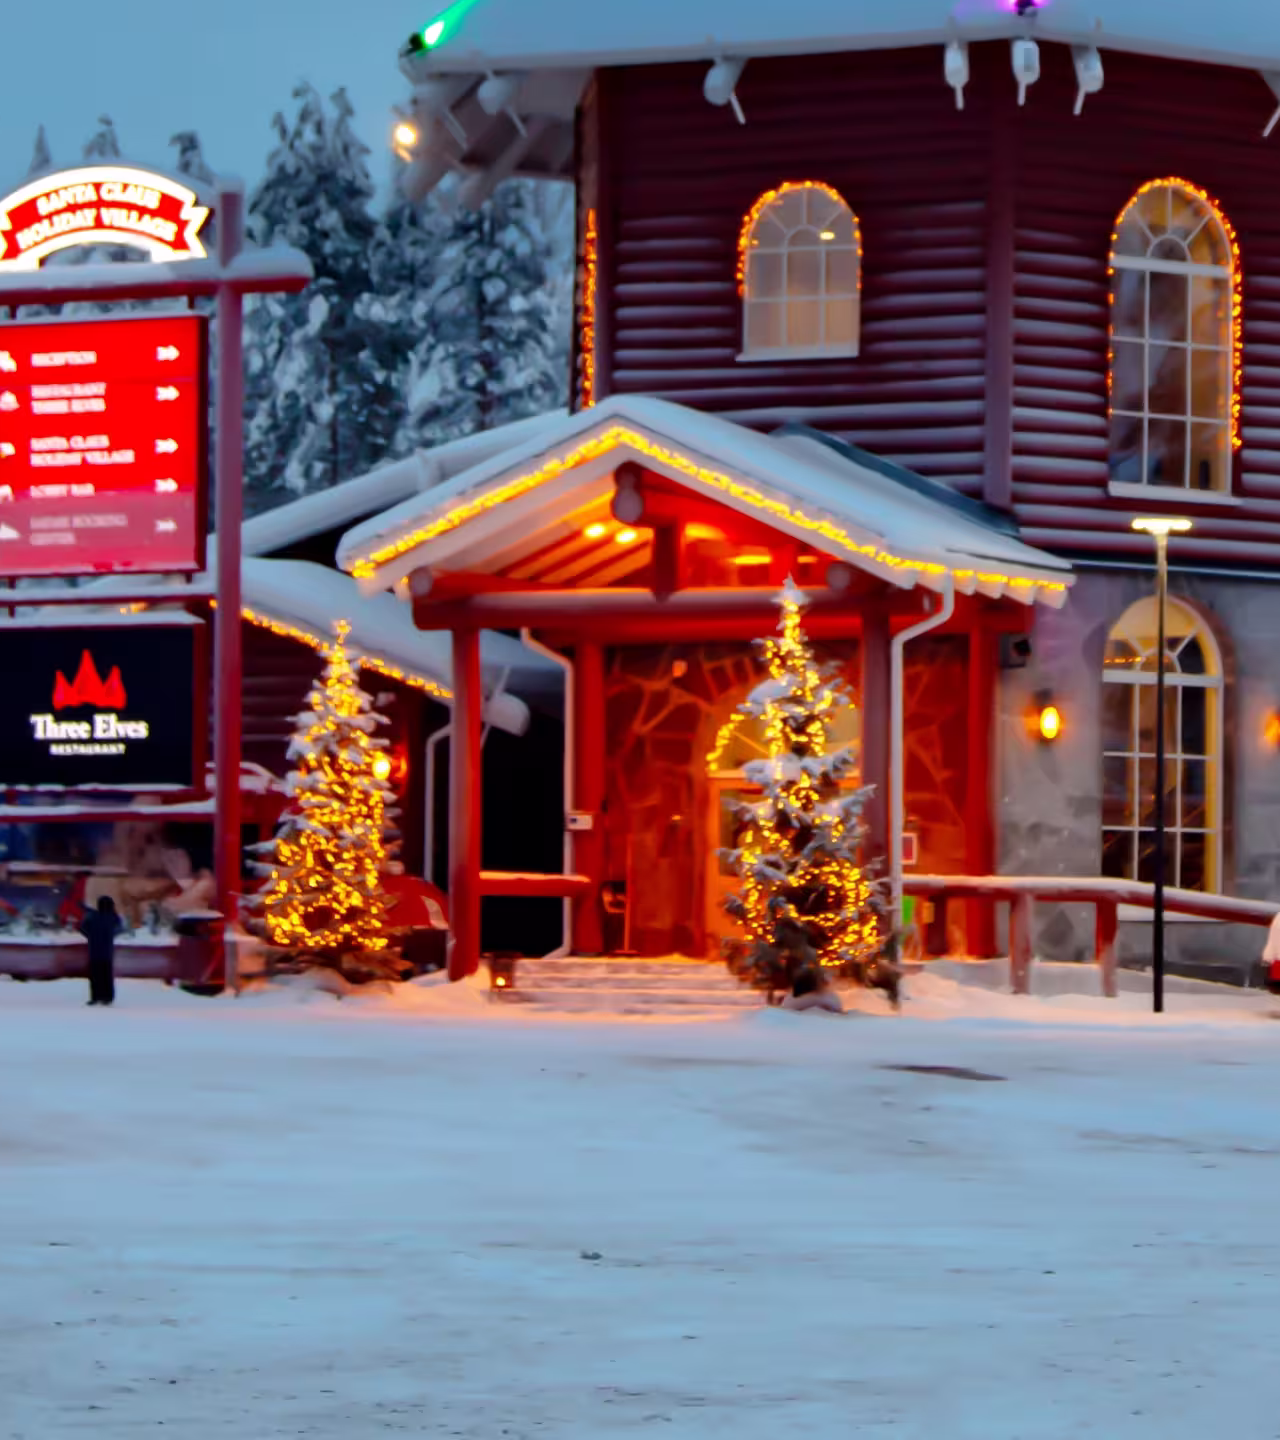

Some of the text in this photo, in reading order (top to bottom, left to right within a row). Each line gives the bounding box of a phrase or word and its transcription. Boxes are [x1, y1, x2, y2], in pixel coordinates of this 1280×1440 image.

[36, 182, 162, 216] SANTA CLAUS
[15, 207, 178, 249] HOLIDAY VILLAGE
[30, 713, 149, 740] Three Elves
